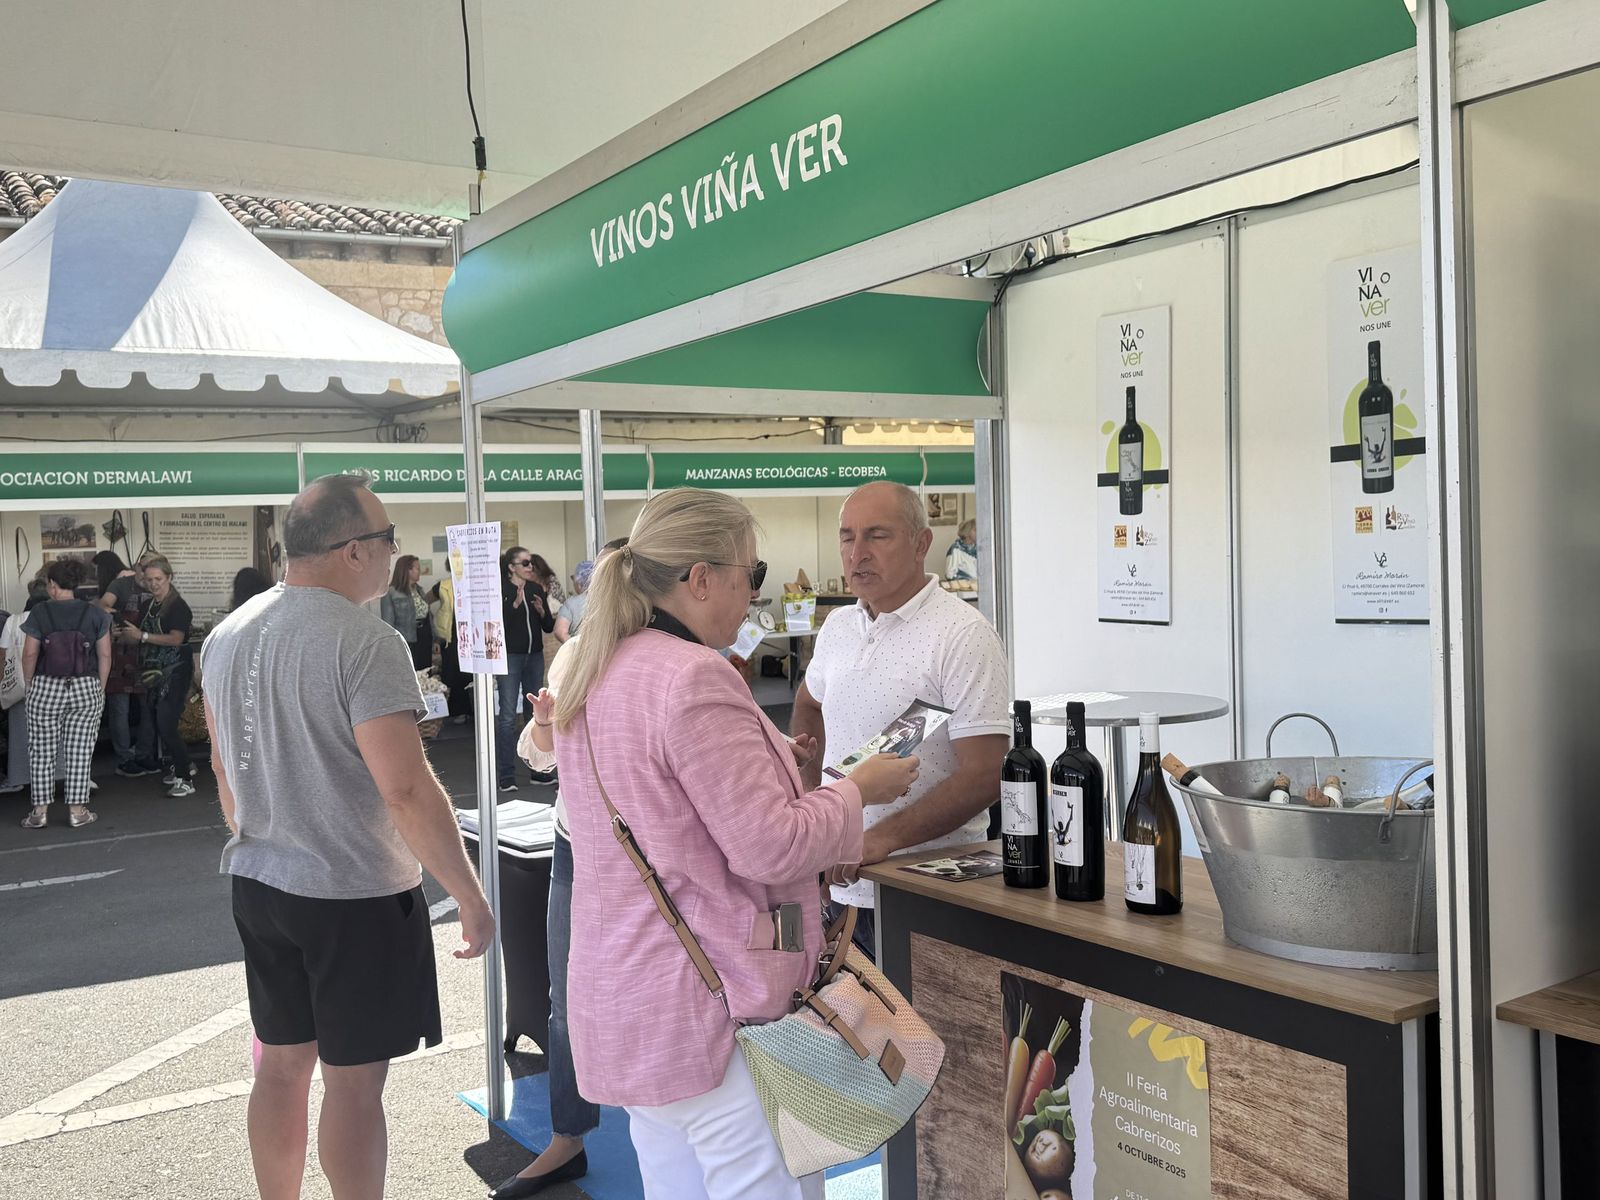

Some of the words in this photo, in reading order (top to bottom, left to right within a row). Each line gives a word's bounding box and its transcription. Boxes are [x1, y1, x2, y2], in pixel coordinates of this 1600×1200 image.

[590, 193, 674, 268] VINOS
[681, 152, 765, 229] VIÑA
[770, 114, 848, 191] VER
[1358, 266, 1372, 283] VI
[1360, 298, 1390, 318] ver
[1120, 323, 1131, 337] VI
[1360, 324, 1375, 332] NOS
[1376, 321, 1391, 330] UNE
[1121, 351, 1143, 367] ver
[1120, 371, 1131, 379] NOS
[0, 471, 88, 486] OCIACION
[94, 471, 192, 484] DERMALAWI
[384, 469, 452, 482] RICARDO
[456, 470, 466, 481] D
[500, 469, 543, 481] CALLE
[685, 468, 752, 480] MANZANAS
[755, 465, 828, 479] ECOLÓGICAS
[838, 466, 887, 477] ECOBESA
[243, 715, 253, 743] ARE
[239, 751, 251, 770] WE
[1008, 850, 1021, 859] ver
[1126, 1072, 1133, 1088] II
[1137, 1076, 1168, 1101] Feria
[1099, 1086, 1198, 1138] Agroalimentaria
[1115, 1115, 1181, 1155] Cabrerizos
[1117, 1141, 1123, 1151] 4
[1125, 1144, 1164, 1169] OCTUBRE
[1165, 1161, 1186, 1179] 2025
[1125, 1189, 1135, 1200] DE
